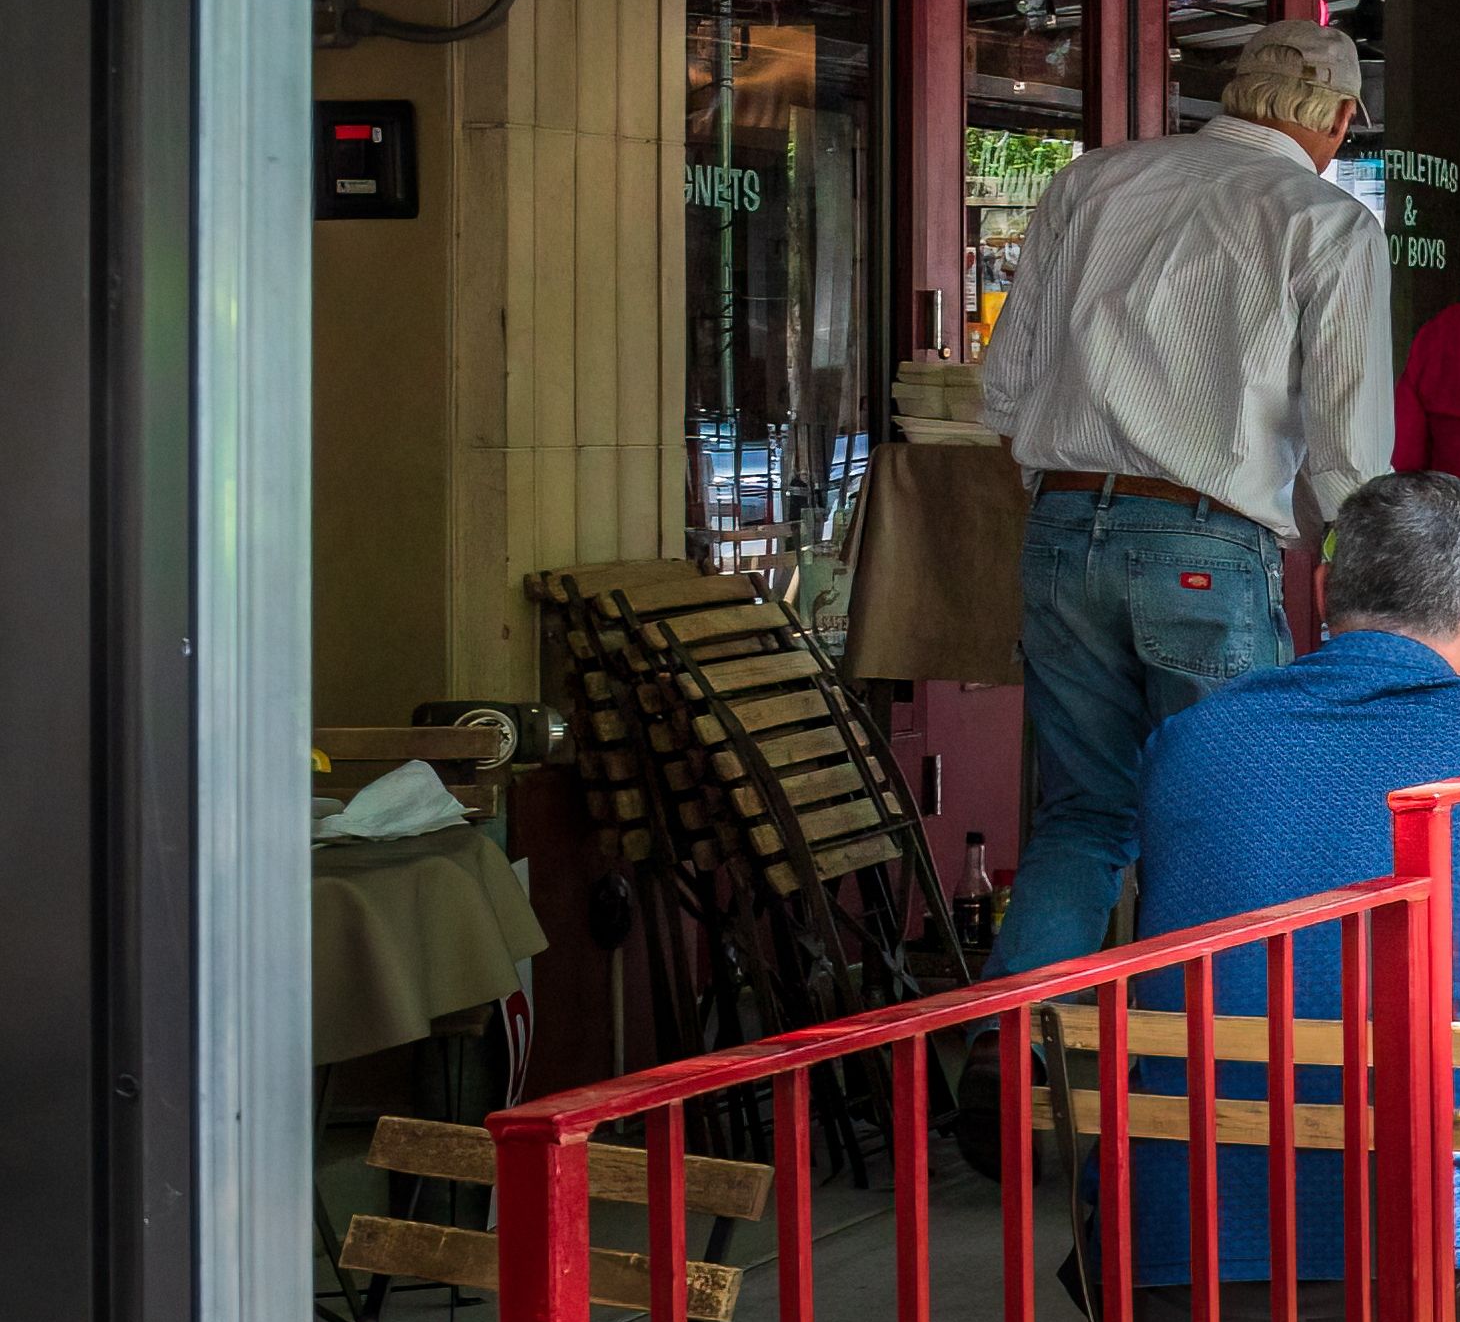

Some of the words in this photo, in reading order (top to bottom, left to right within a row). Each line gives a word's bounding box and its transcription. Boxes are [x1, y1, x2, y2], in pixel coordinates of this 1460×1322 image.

[1361, 149, 1459, 193] FFULETTAS
[1404, 195, 1418, 226] &
[1408, 236, 1447, 270] BOYS
